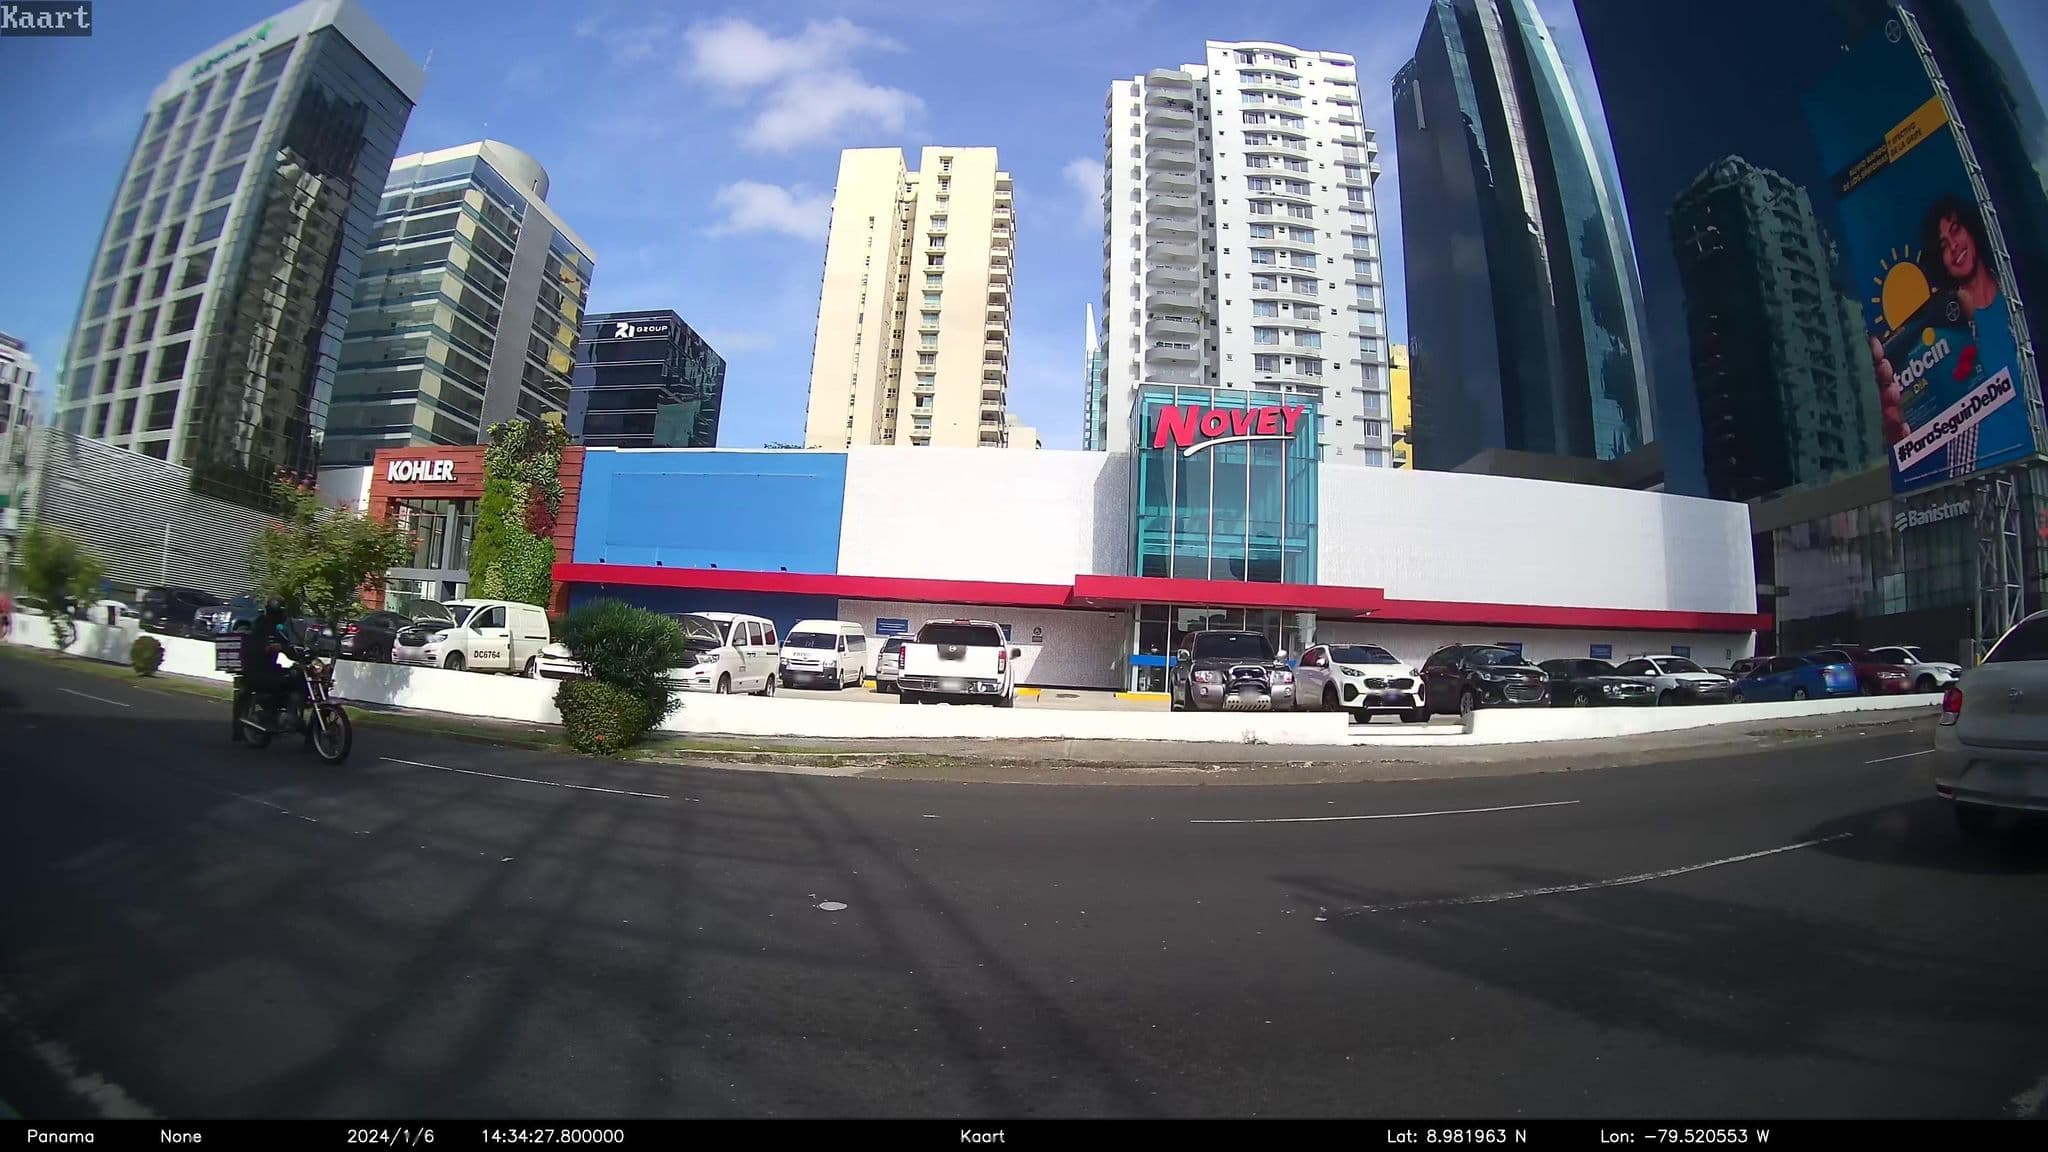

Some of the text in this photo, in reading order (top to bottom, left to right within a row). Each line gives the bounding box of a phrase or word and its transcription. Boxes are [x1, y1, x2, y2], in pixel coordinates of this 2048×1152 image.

[1893, 338, 1951, 392] tabcin
[1898, 377, 2012, 463] #ParaSeguirDeDía
[1908, 500, 1970, 527] Banistmo
[474, 650, 500, 658] DC6764
